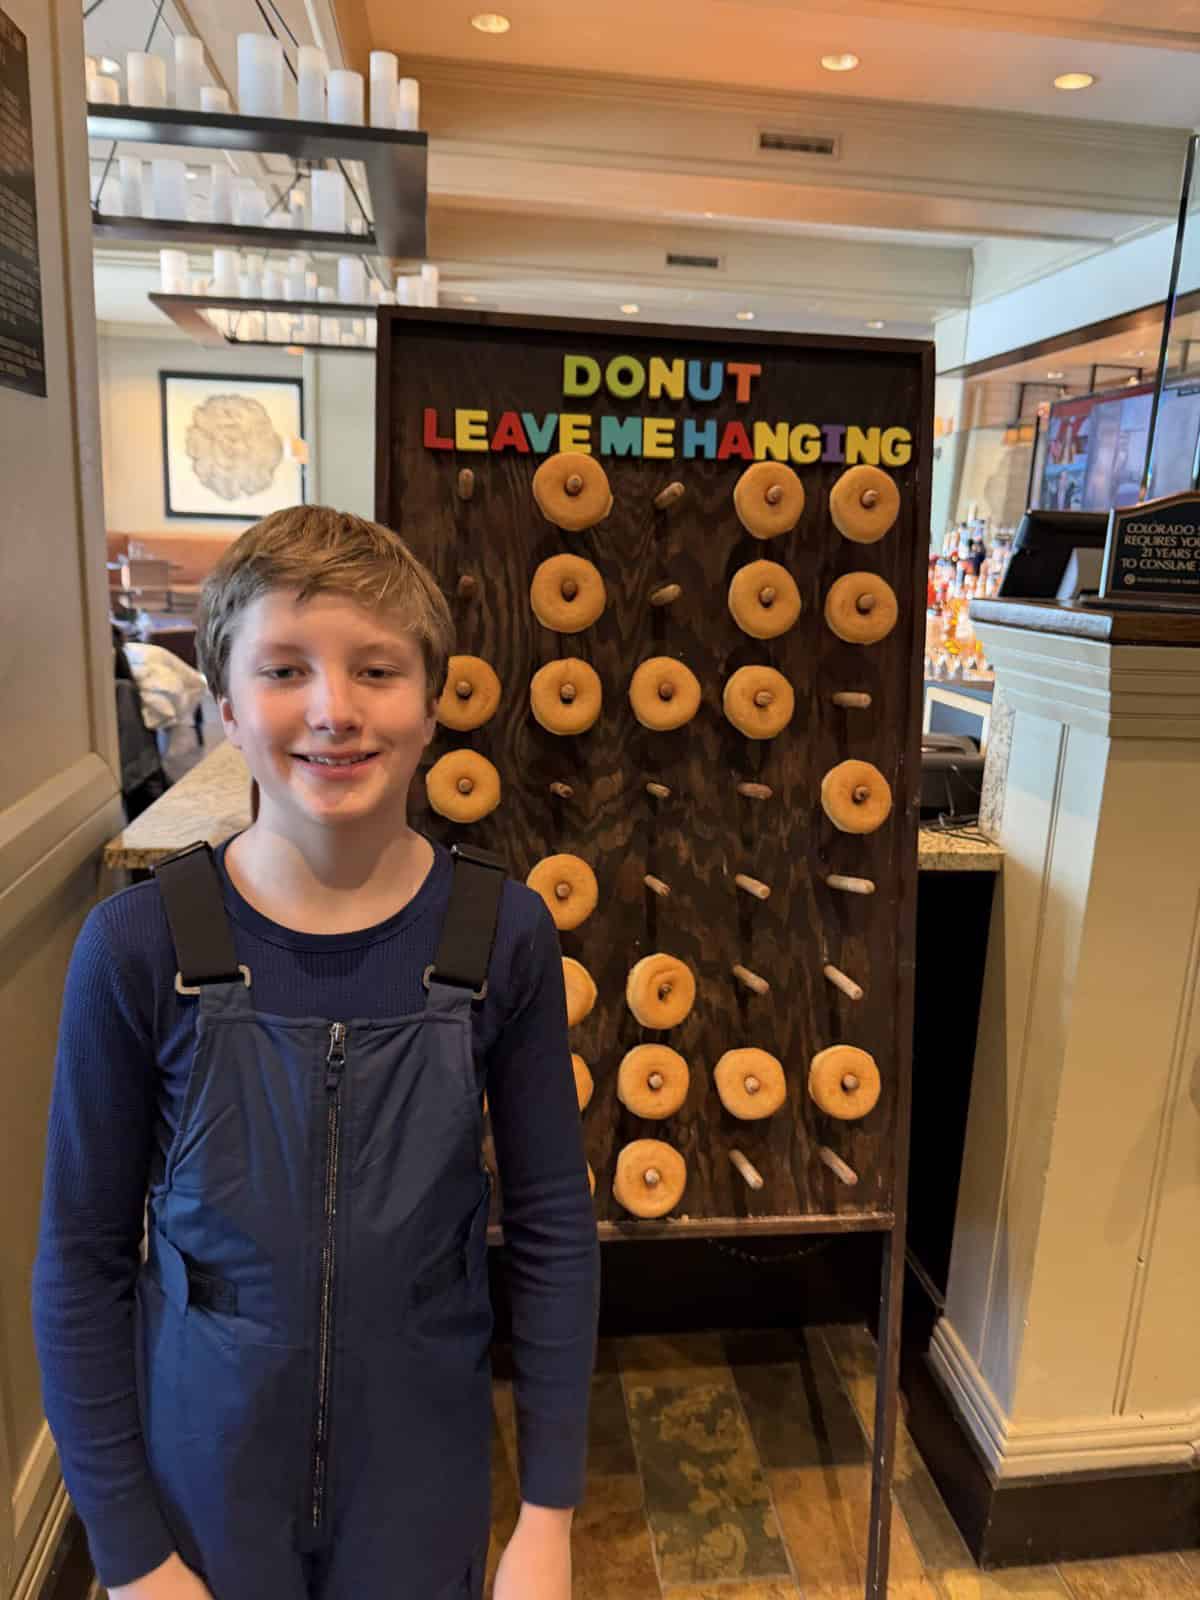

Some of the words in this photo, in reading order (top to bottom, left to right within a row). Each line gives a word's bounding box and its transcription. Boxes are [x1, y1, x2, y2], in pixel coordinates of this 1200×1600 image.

[563, 355, 762, 403] DONUT
[423, 408, 592, 453] LEAVE
[600, 415, 675, 459] ME
[683, 418, 912, 467] HANGING
[1126, 523, 1194, 535] COLORADO
[1124, 536, 1177, 547] REQUIRES
[1141, 547, 1152, 557] 21
[1156, 548, 1191, 559] YEARS
[1121, 558, 1137, 568] TO
[1139, 560, 1196, 571] CONSUME
